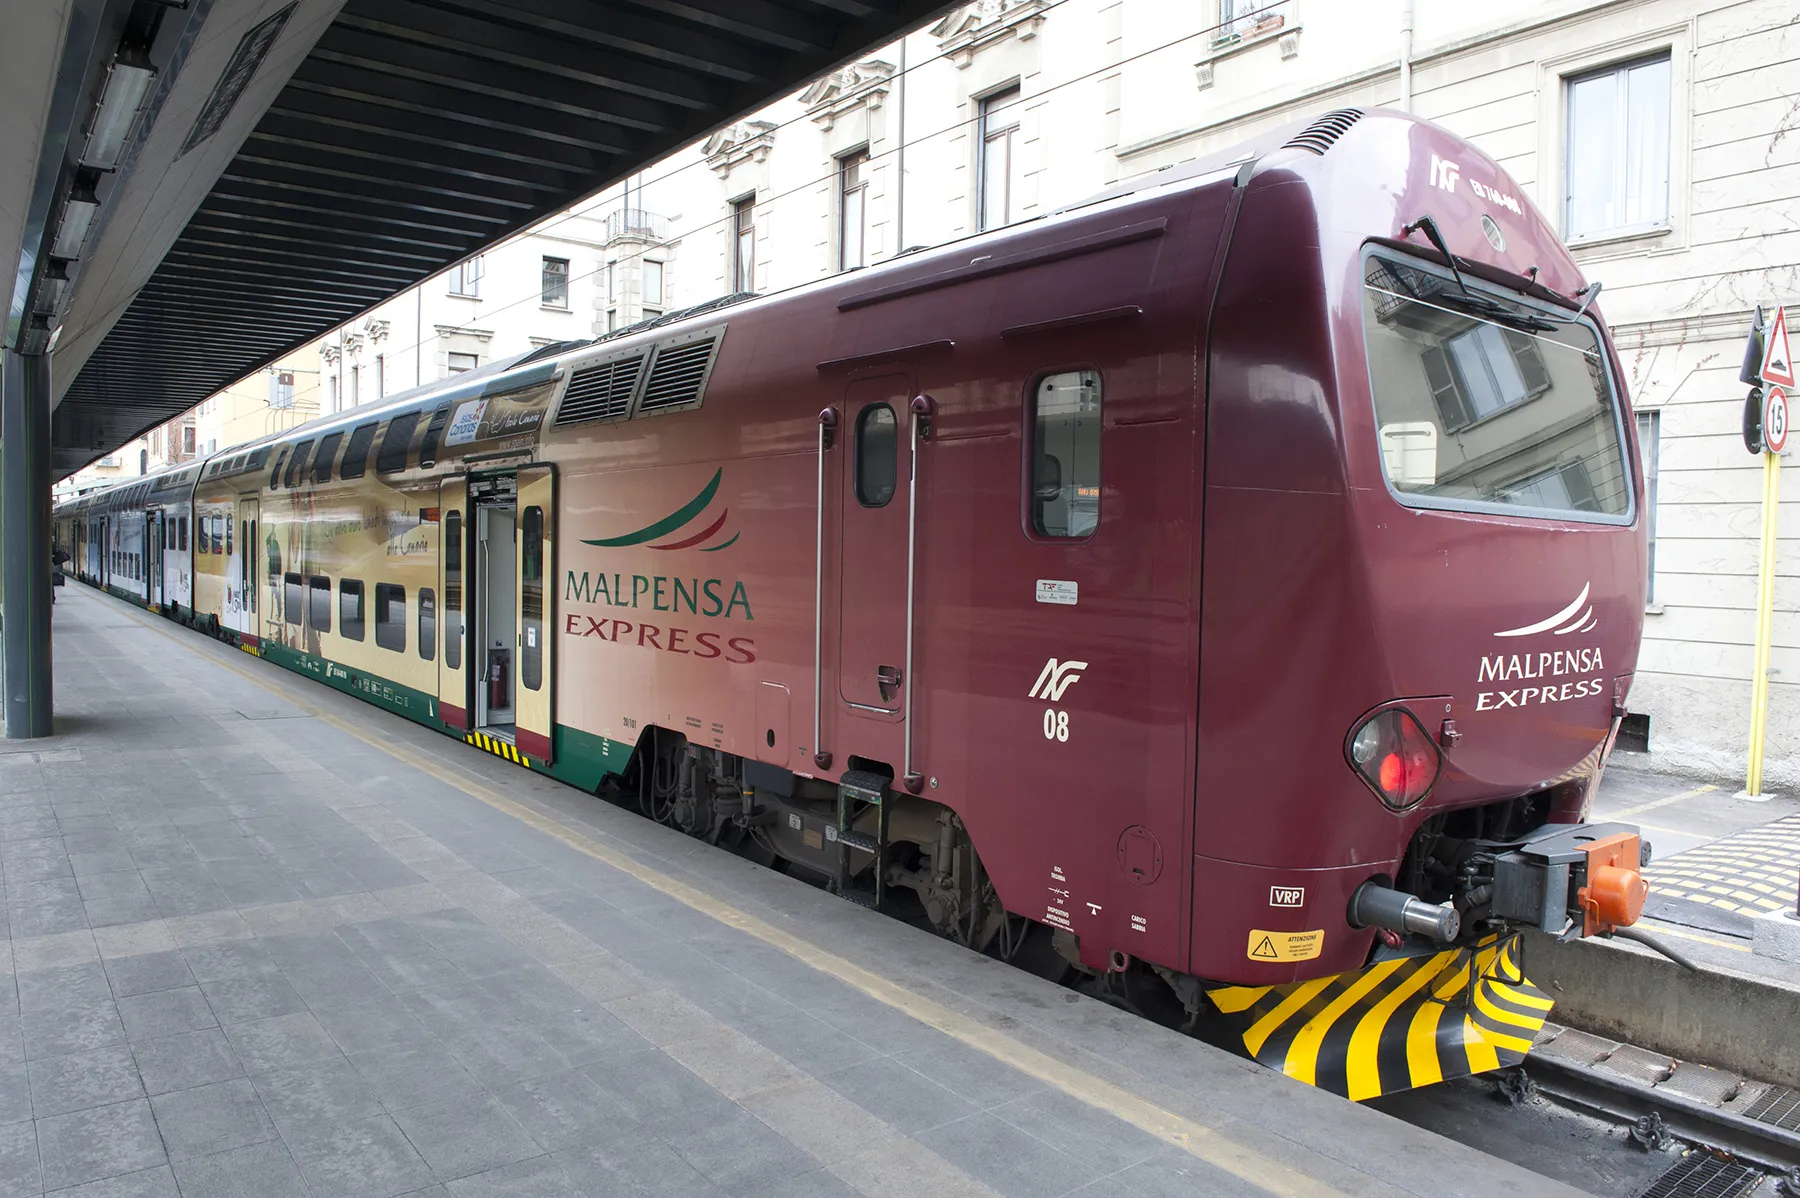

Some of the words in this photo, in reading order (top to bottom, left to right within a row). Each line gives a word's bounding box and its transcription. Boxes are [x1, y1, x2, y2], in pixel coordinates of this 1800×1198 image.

[1771, 404, 1783, 436] 15
[564, 570, 755, 621] MALPENSA
[564, 613, 756, 664] EXPRESS
[1477, 647, 1604, 682] MALPENSA
[1475, 678, 1603, 711] EXPRESS
[1043, 708, 1069, 743] 08
[1275, 890, 1300, 904] VRP
[1287, 934, 1317, 943] ATTENZIONE
